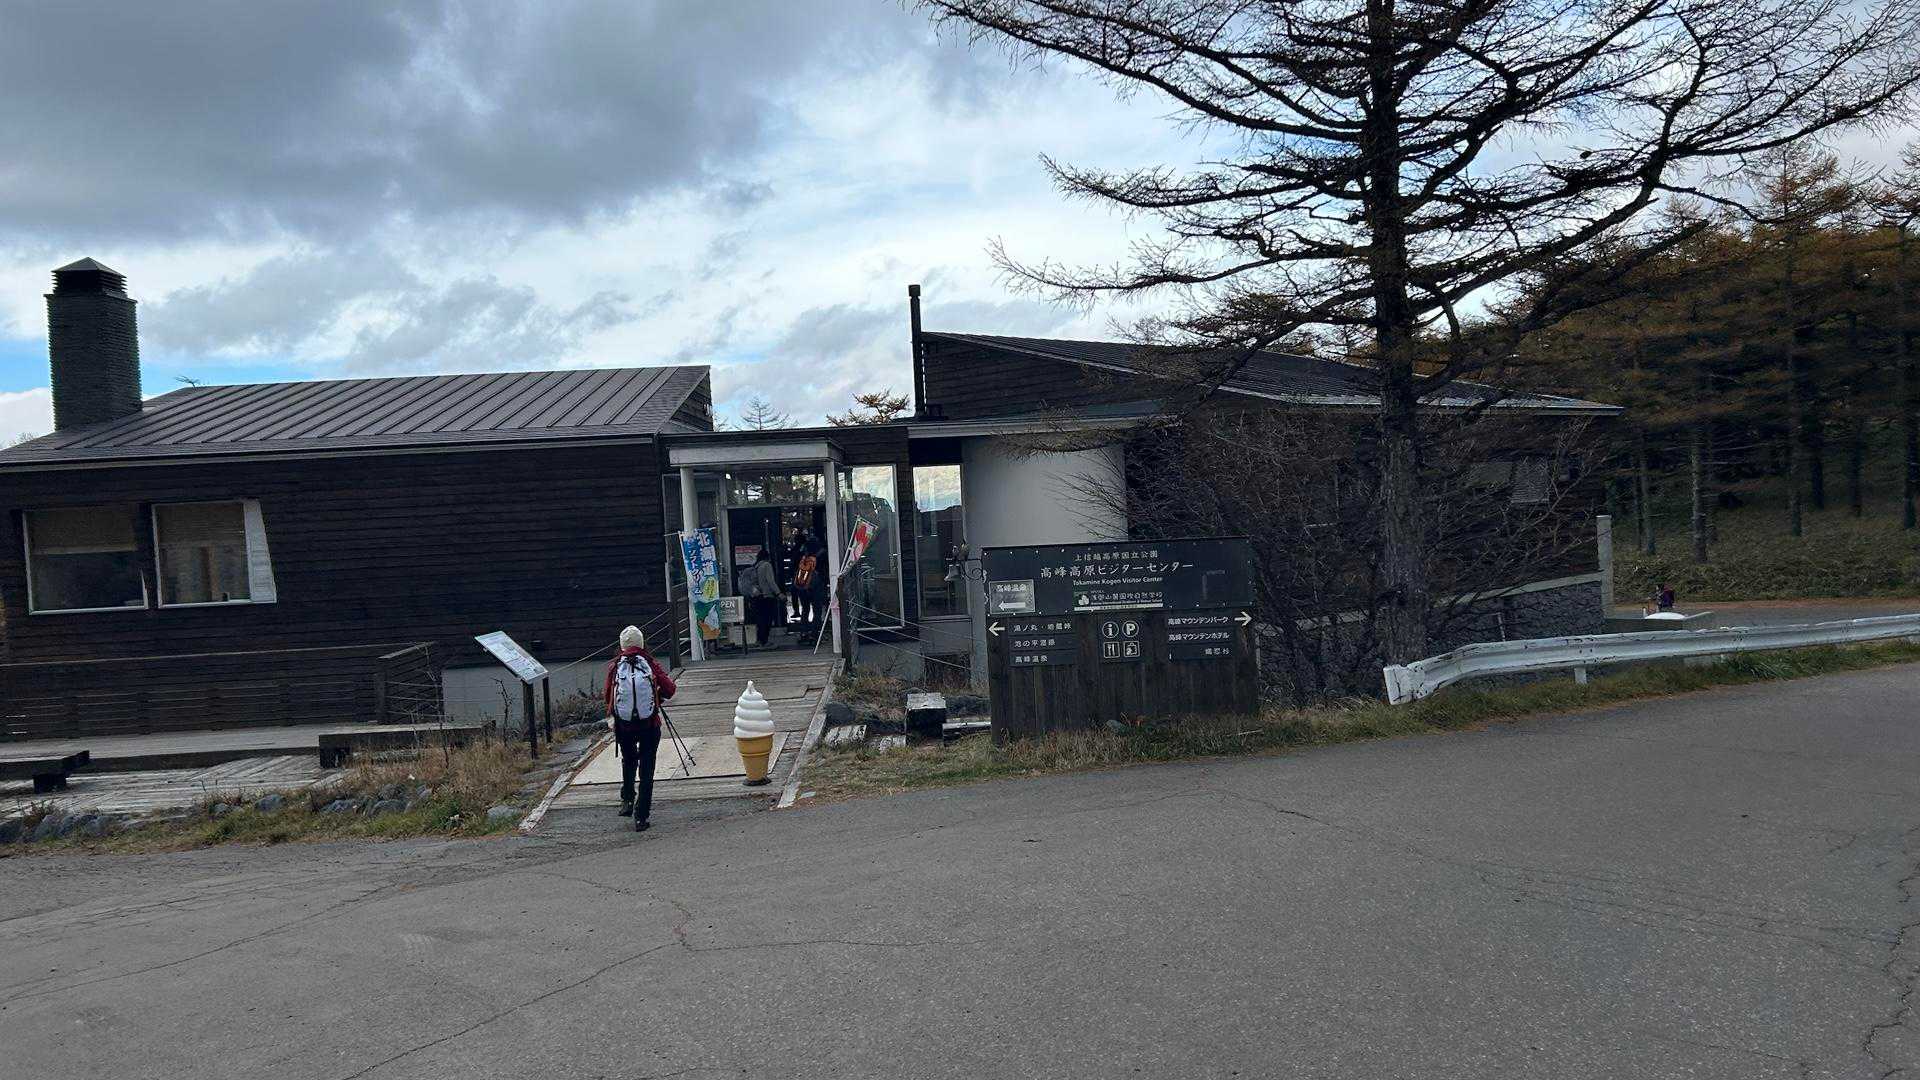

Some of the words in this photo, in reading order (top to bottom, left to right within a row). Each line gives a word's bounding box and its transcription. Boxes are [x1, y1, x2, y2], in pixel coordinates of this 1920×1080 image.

[1074, 550, 1158, 562] 上信越高原国立公園
[688, 550, 704, 595] ソフトクリーム
[1040, 561, 1193, 578] 高峰高原ビジターセンター
[996, 584, 1027, 592] 高峰温泉
[1168, 616, 1229, 625] 高峰マウンテンパーク
[1168, 632, 1230, 641] 高峰マウンテンホテル
[1015, 655, 1048, 663] 高峰温泉
